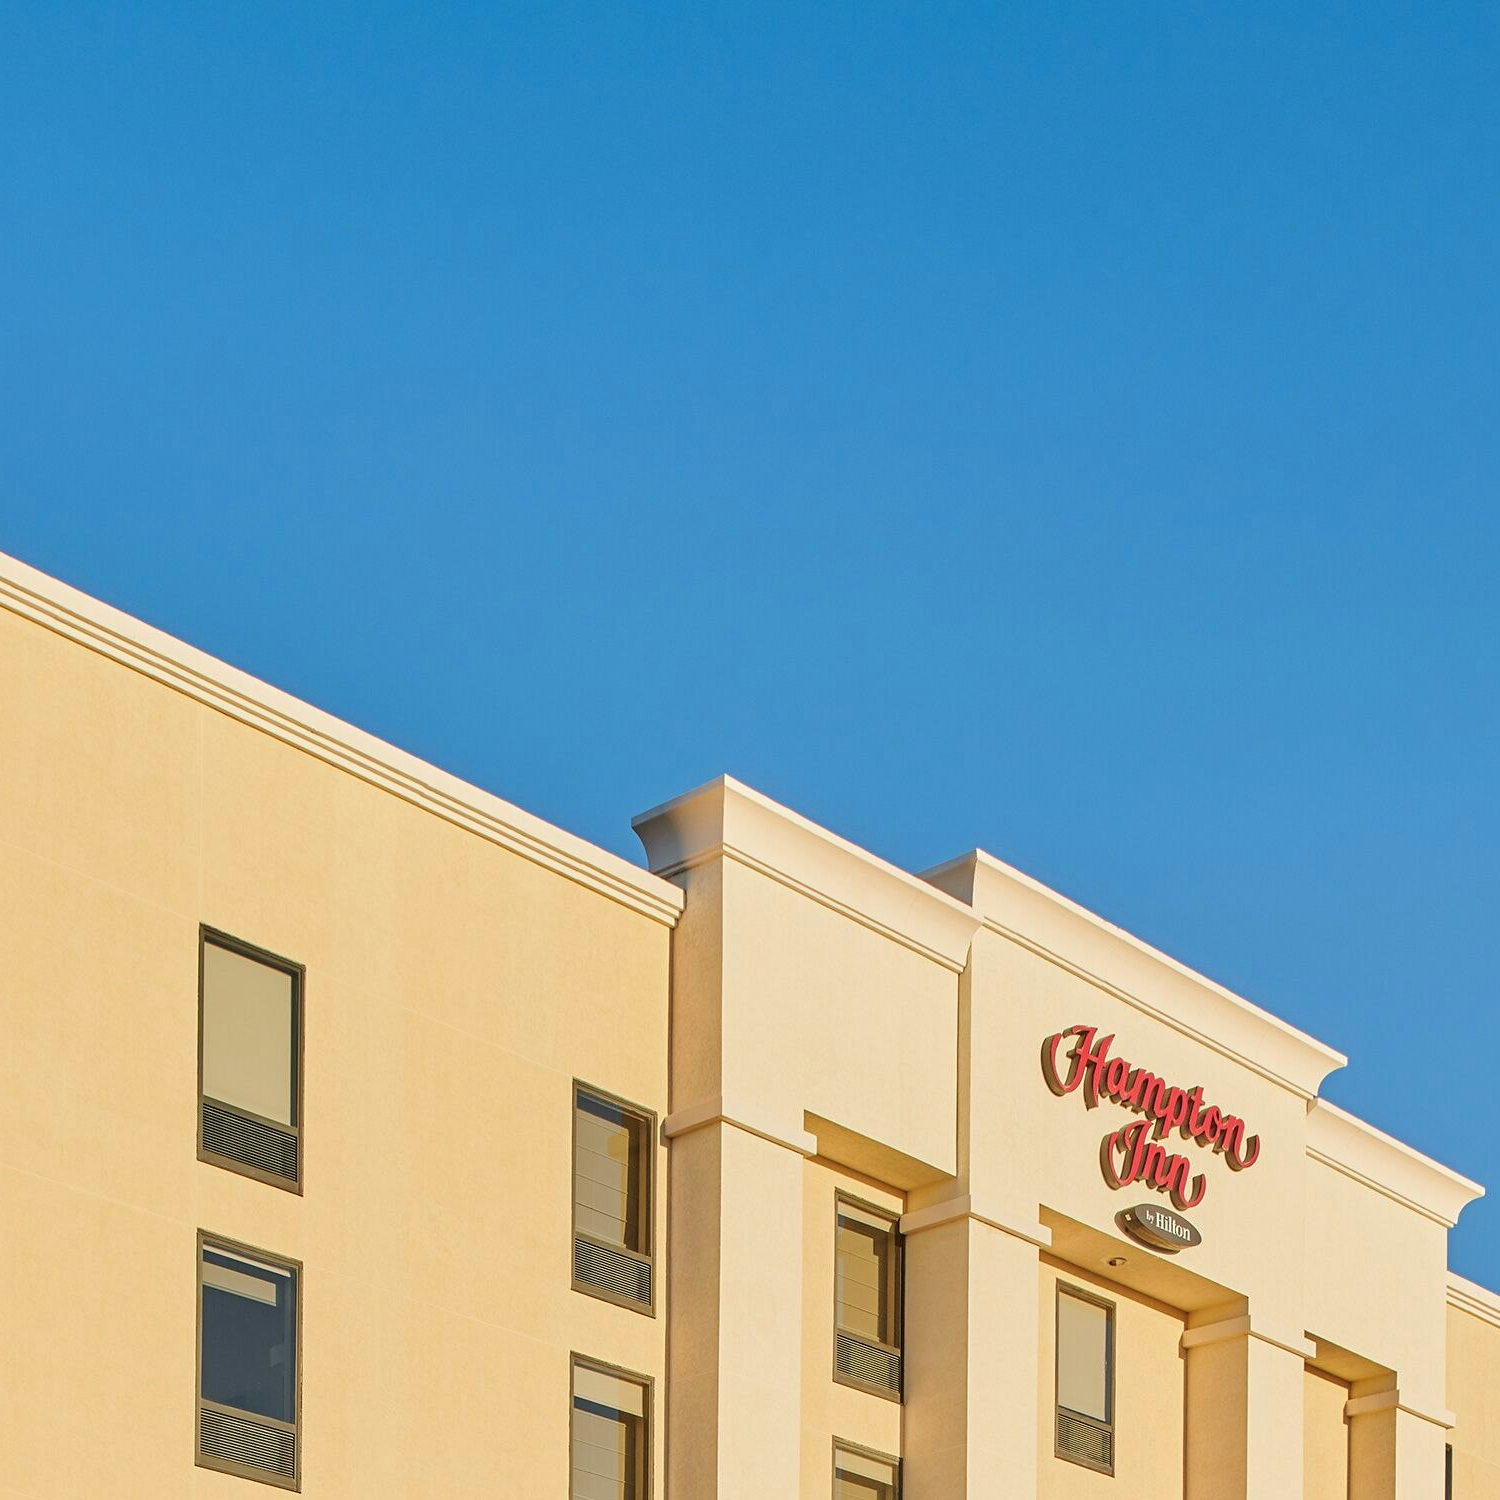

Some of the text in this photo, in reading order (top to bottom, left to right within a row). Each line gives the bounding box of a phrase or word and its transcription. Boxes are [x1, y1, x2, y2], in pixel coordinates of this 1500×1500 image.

[1042, 1025, 1260, 1171] Hampton
[1100, 1120, 1206, 1210] Inn
[1146, 1210, 1191, 1242] by Hilton
